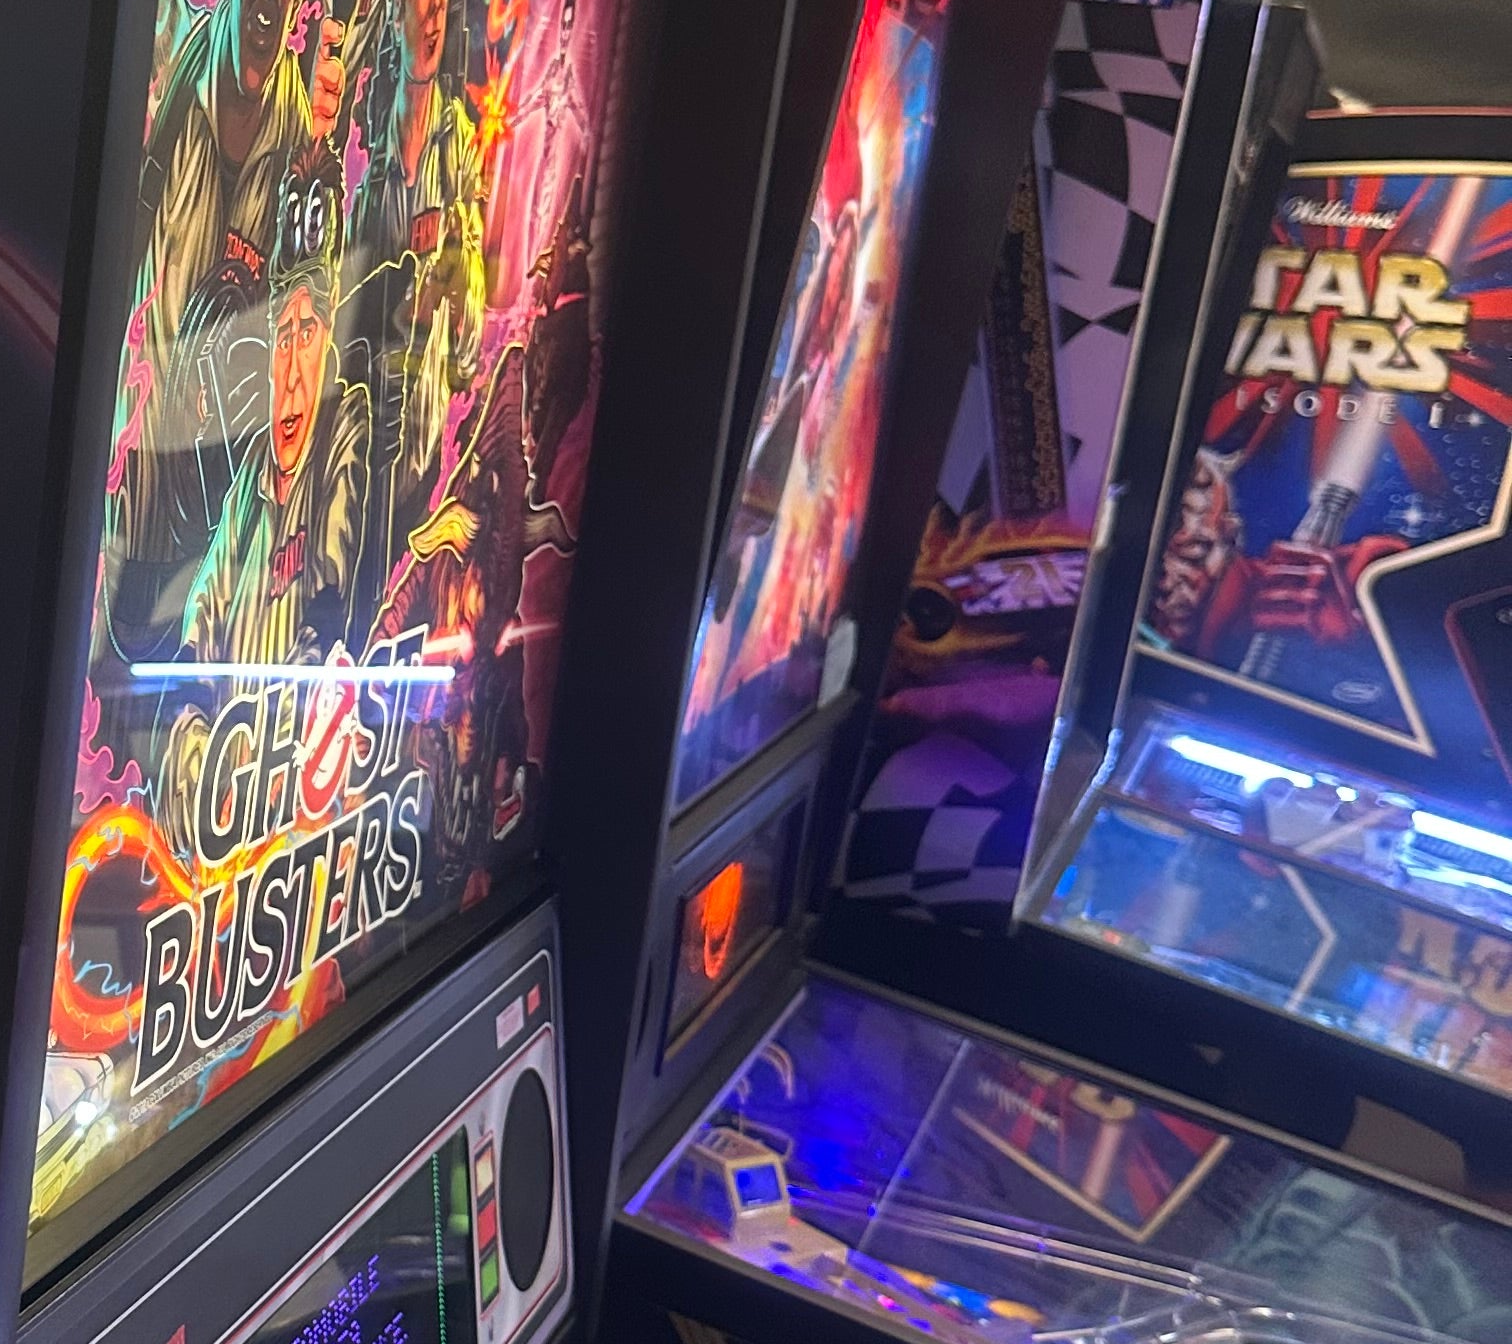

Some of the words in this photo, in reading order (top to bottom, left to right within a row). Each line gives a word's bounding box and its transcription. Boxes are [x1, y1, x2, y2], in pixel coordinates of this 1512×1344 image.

[1224, 312, 1467, 392] ARS
[194, 623, 430, 867] GHOST
[131, 767, 425, 1096] BUSTERS
